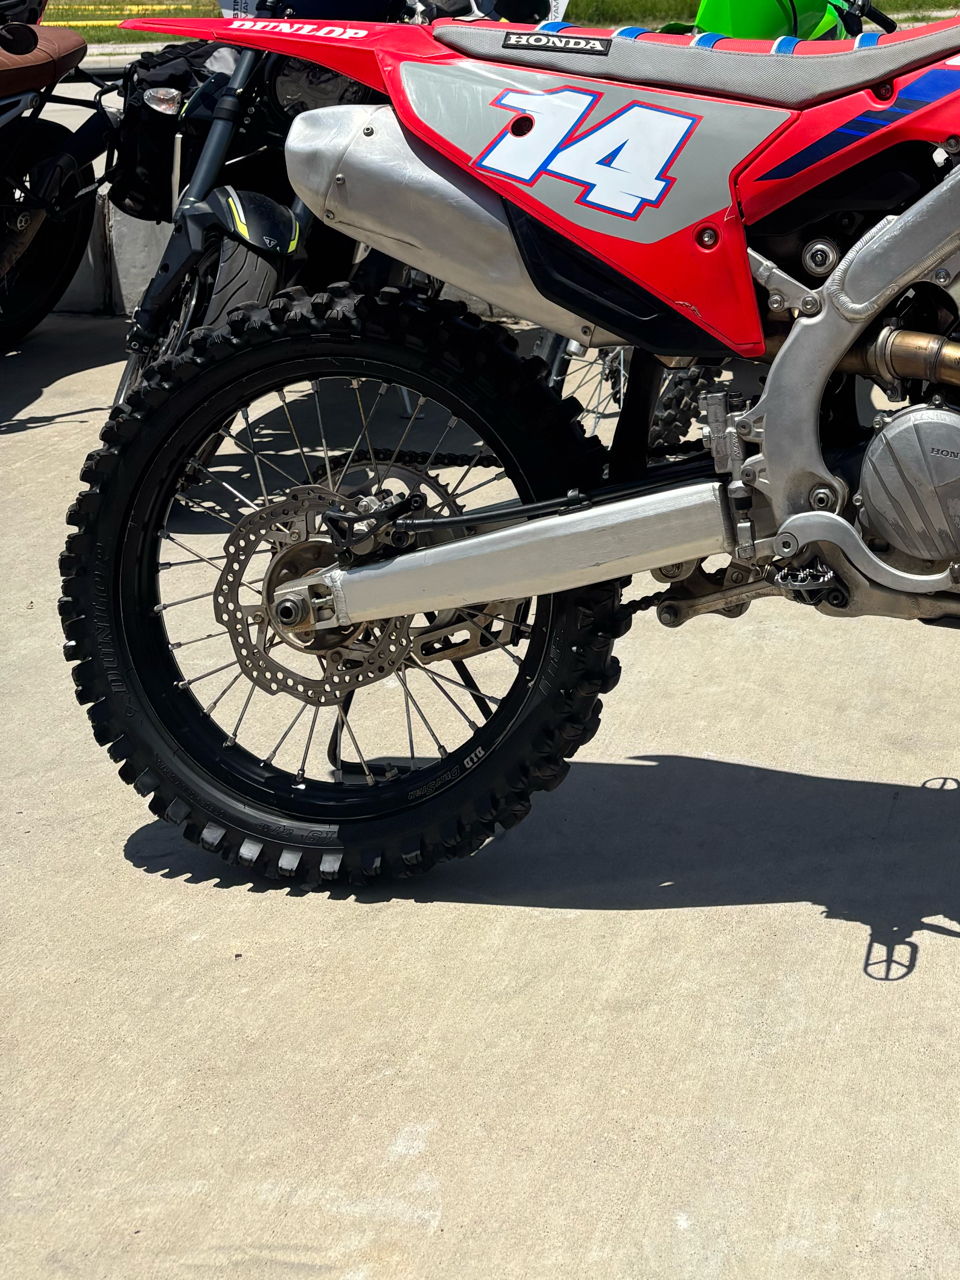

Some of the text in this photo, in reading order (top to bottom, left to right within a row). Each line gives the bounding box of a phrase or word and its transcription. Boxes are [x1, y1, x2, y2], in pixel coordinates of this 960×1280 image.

[228, 20, 369, 40] DUNLOP
[507, 34, 605, 51] HONDA
[474, 86, 702, 221] 14
[92, 543, 130, 695] DUNLOP
